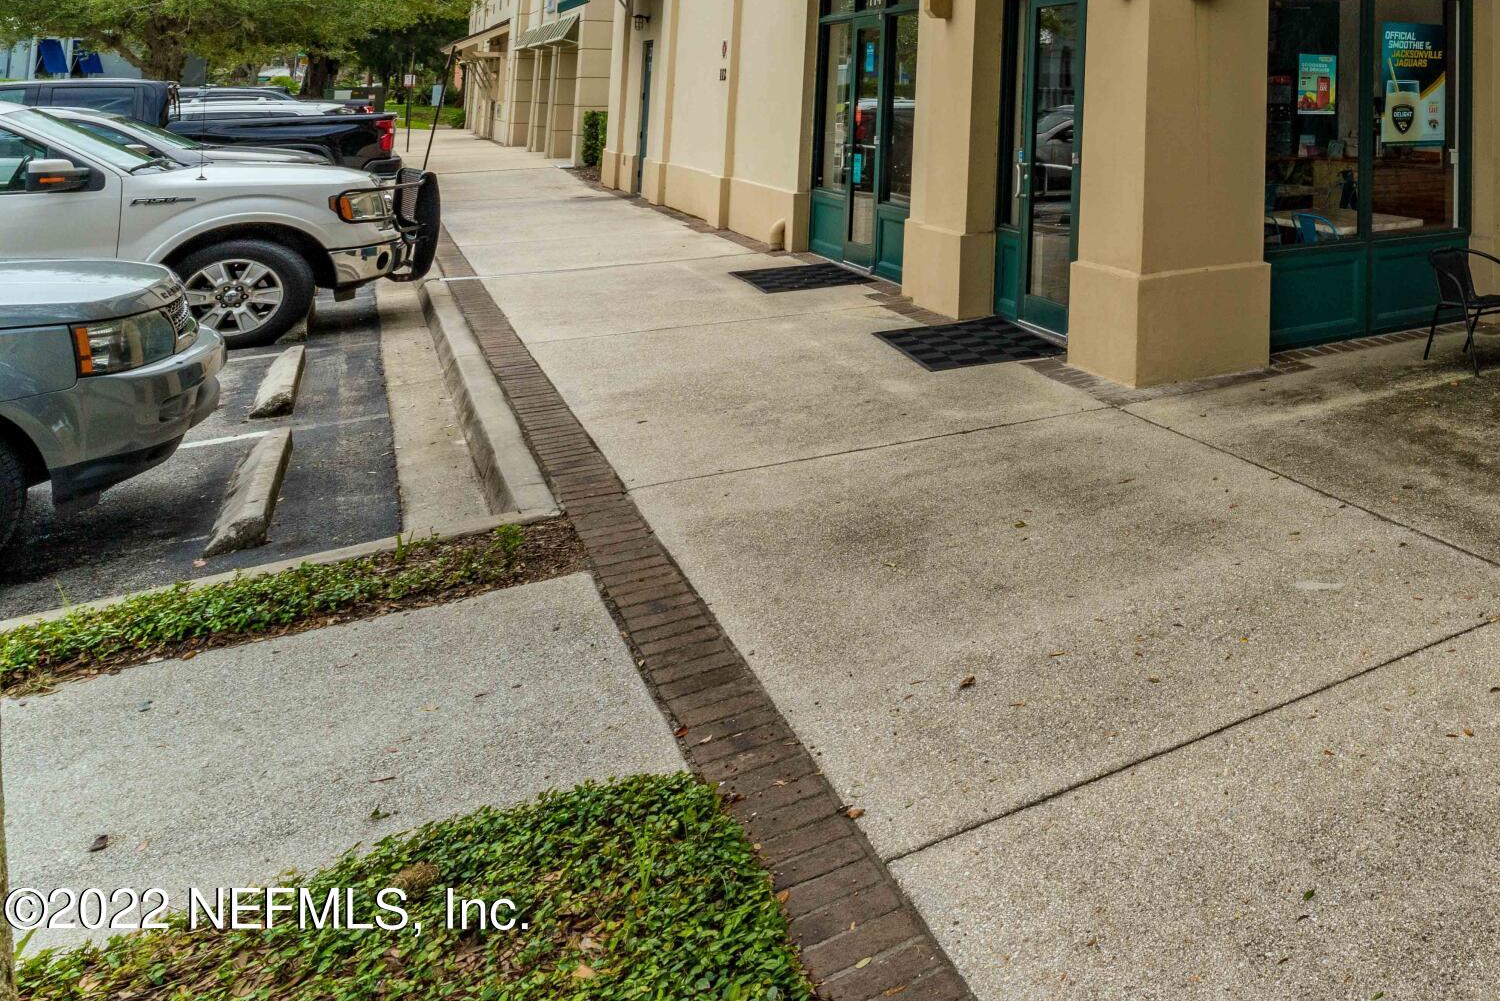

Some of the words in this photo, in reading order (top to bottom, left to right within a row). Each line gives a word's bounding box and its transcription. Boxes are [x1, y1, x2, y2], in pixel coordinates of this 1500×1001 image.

[1385, 31, 1416, 40] OFFICIAL
[1388, 40, 1424, 50] SMOOTHIE
[1392, 50, 1443, 60] JACKSONVILLE
[1394, 59, 1427, 68] JAGUARS
